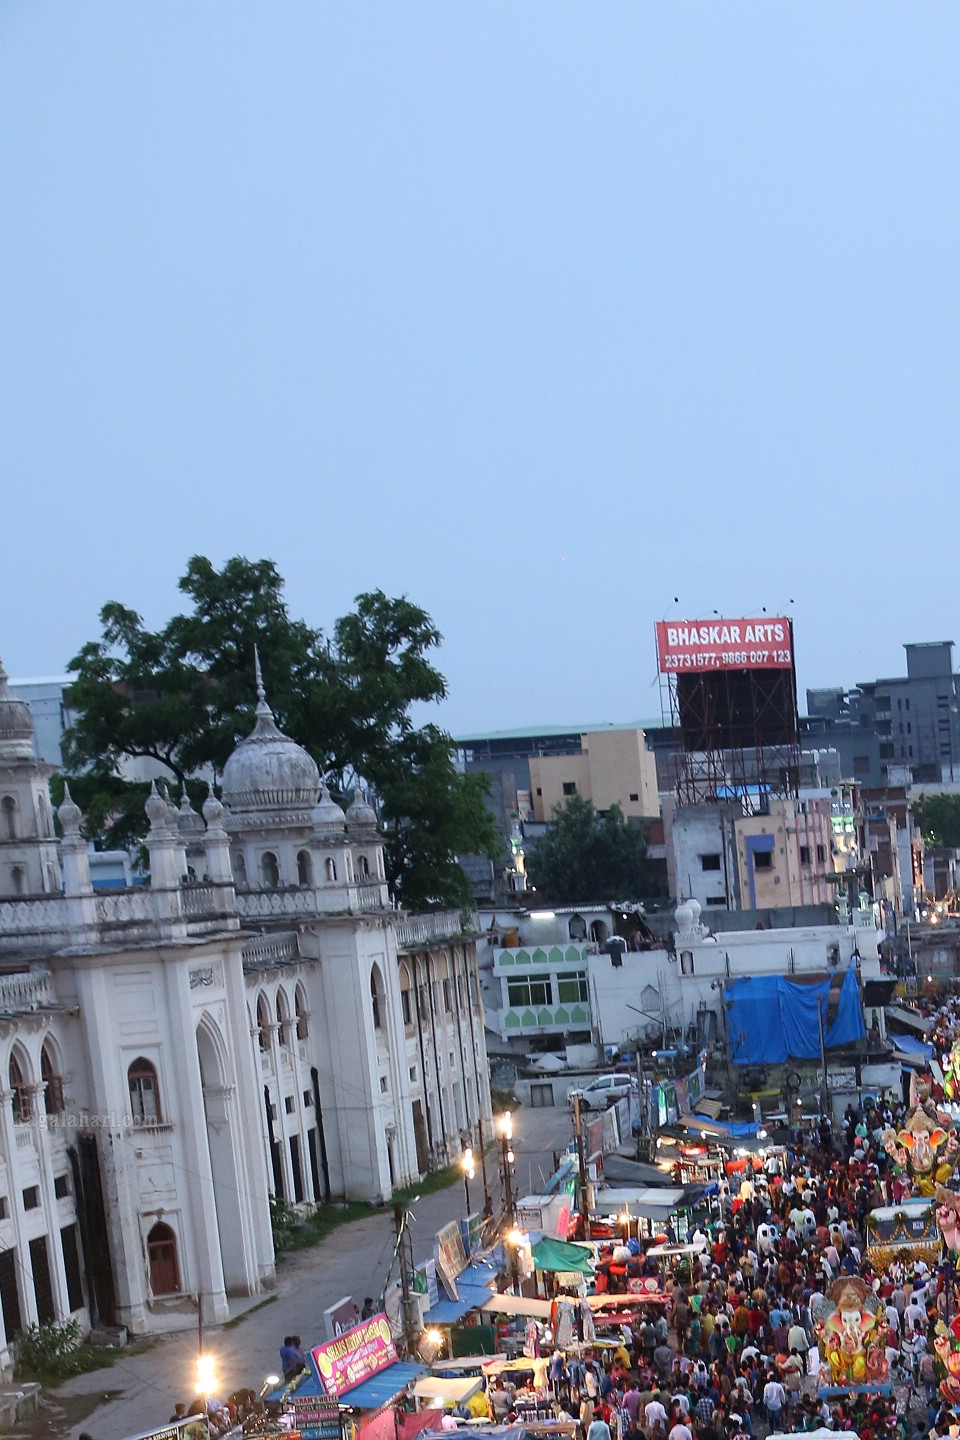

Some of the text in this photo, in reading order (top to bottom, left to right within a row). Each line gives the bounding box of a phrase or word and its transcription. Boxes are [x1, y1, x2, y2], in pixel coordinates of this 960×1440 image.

[667, 623, 784, 646] BHASKAR ARTS
[665, 652, 720, 668] 23731577,
[750, 650, 768, 663] 007
[772, 649, 791, 663] 123
